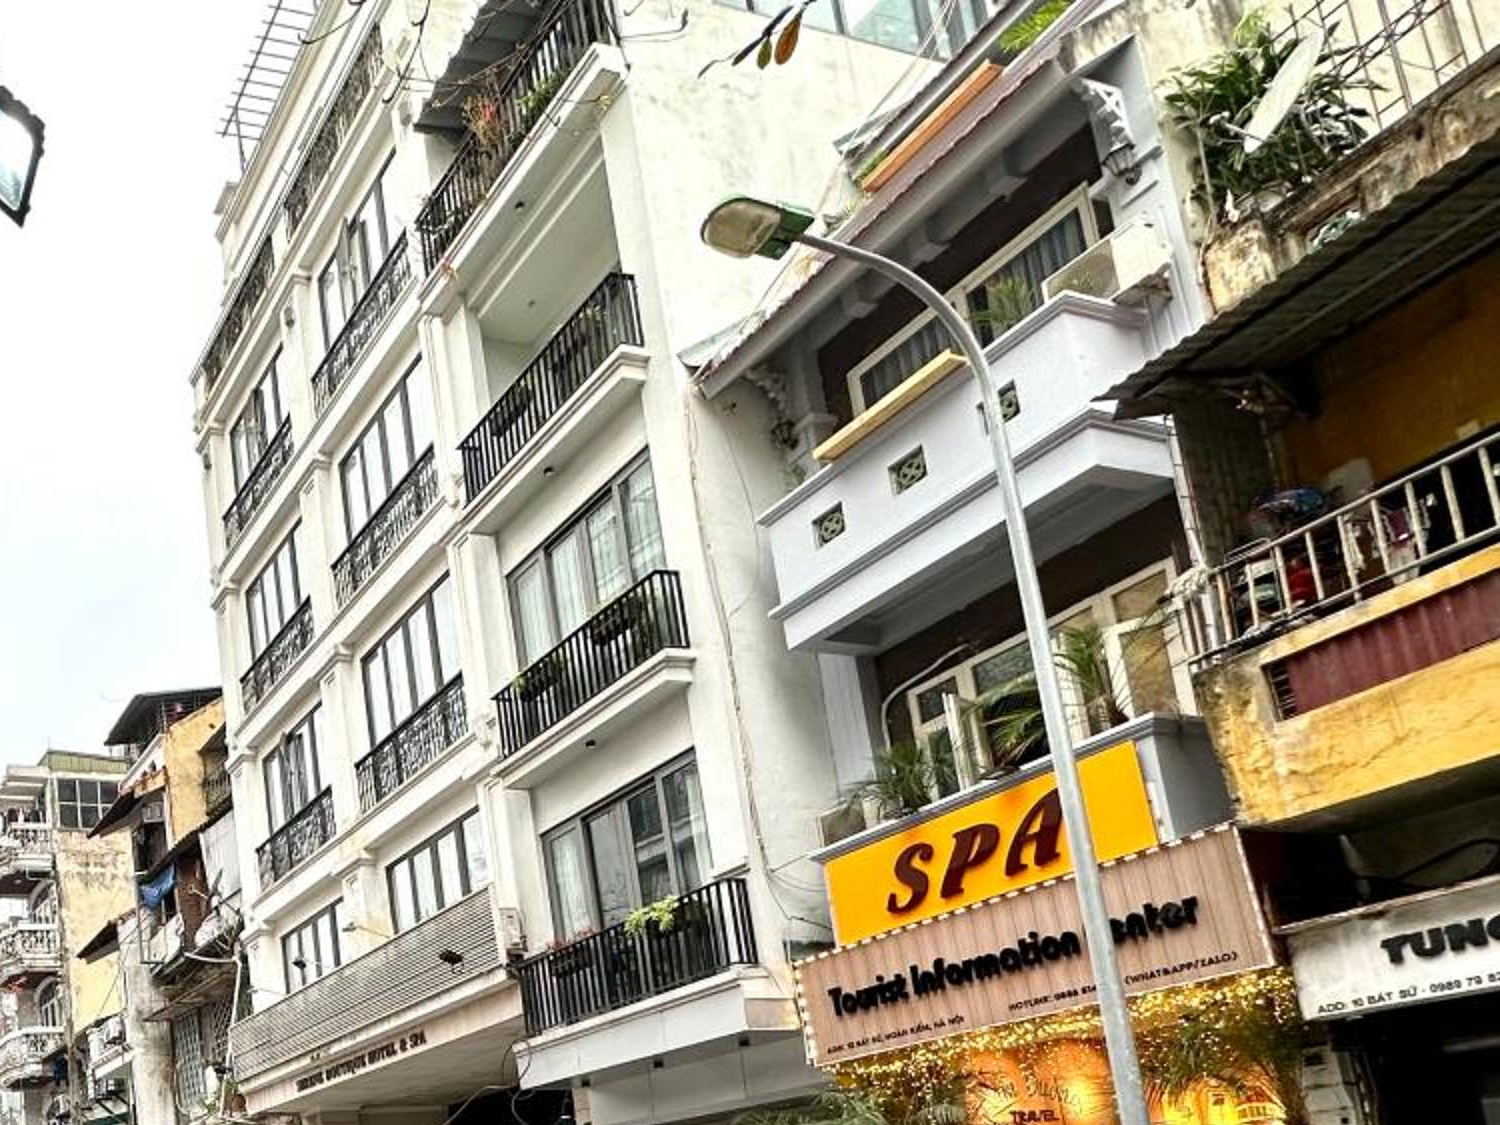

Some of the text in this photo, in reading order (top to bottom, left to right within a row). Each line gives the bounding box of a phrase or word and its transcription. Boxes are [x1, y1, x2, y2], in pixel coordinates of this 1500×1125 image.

[886, 788, 1064, 915] SPA
[828, 895, 1199, 1018] Tourist Information enter
[1367, 991, 1393, 1005] BÁT
